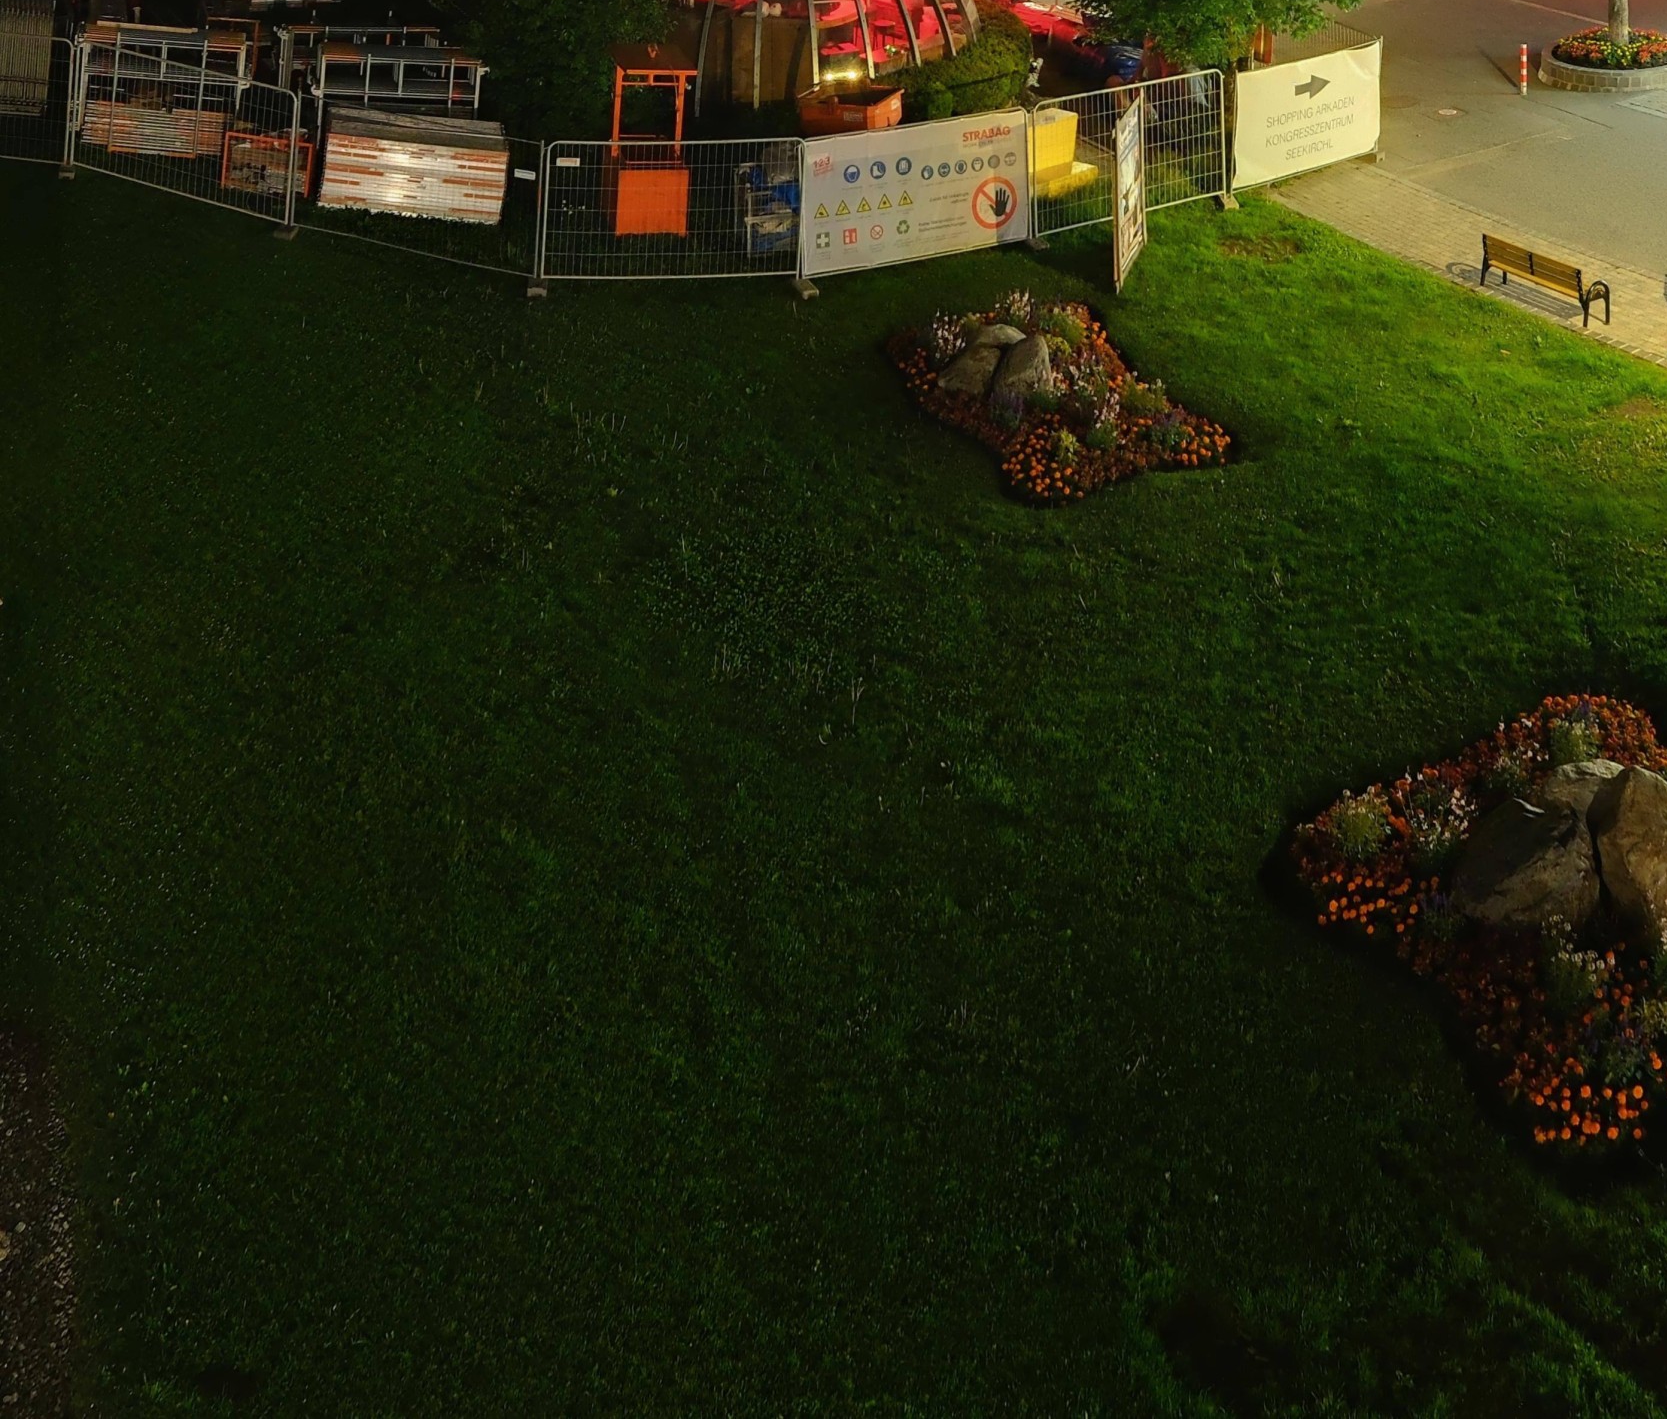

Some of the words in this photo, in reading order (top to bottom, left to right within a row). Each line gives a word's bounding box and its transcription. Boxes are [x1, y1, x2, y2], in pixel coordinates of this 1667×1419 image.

[1265, 108, 1314, 129] SHOPPING
[1314, 95, 1355, 116] ARKADEN
[961, 125, 1012, 143] STRABAG
[1264, 113, 1354, 148] KONGRESSZENTRUM
[1285, 138, 1334, 161] SEEKIRCHL
